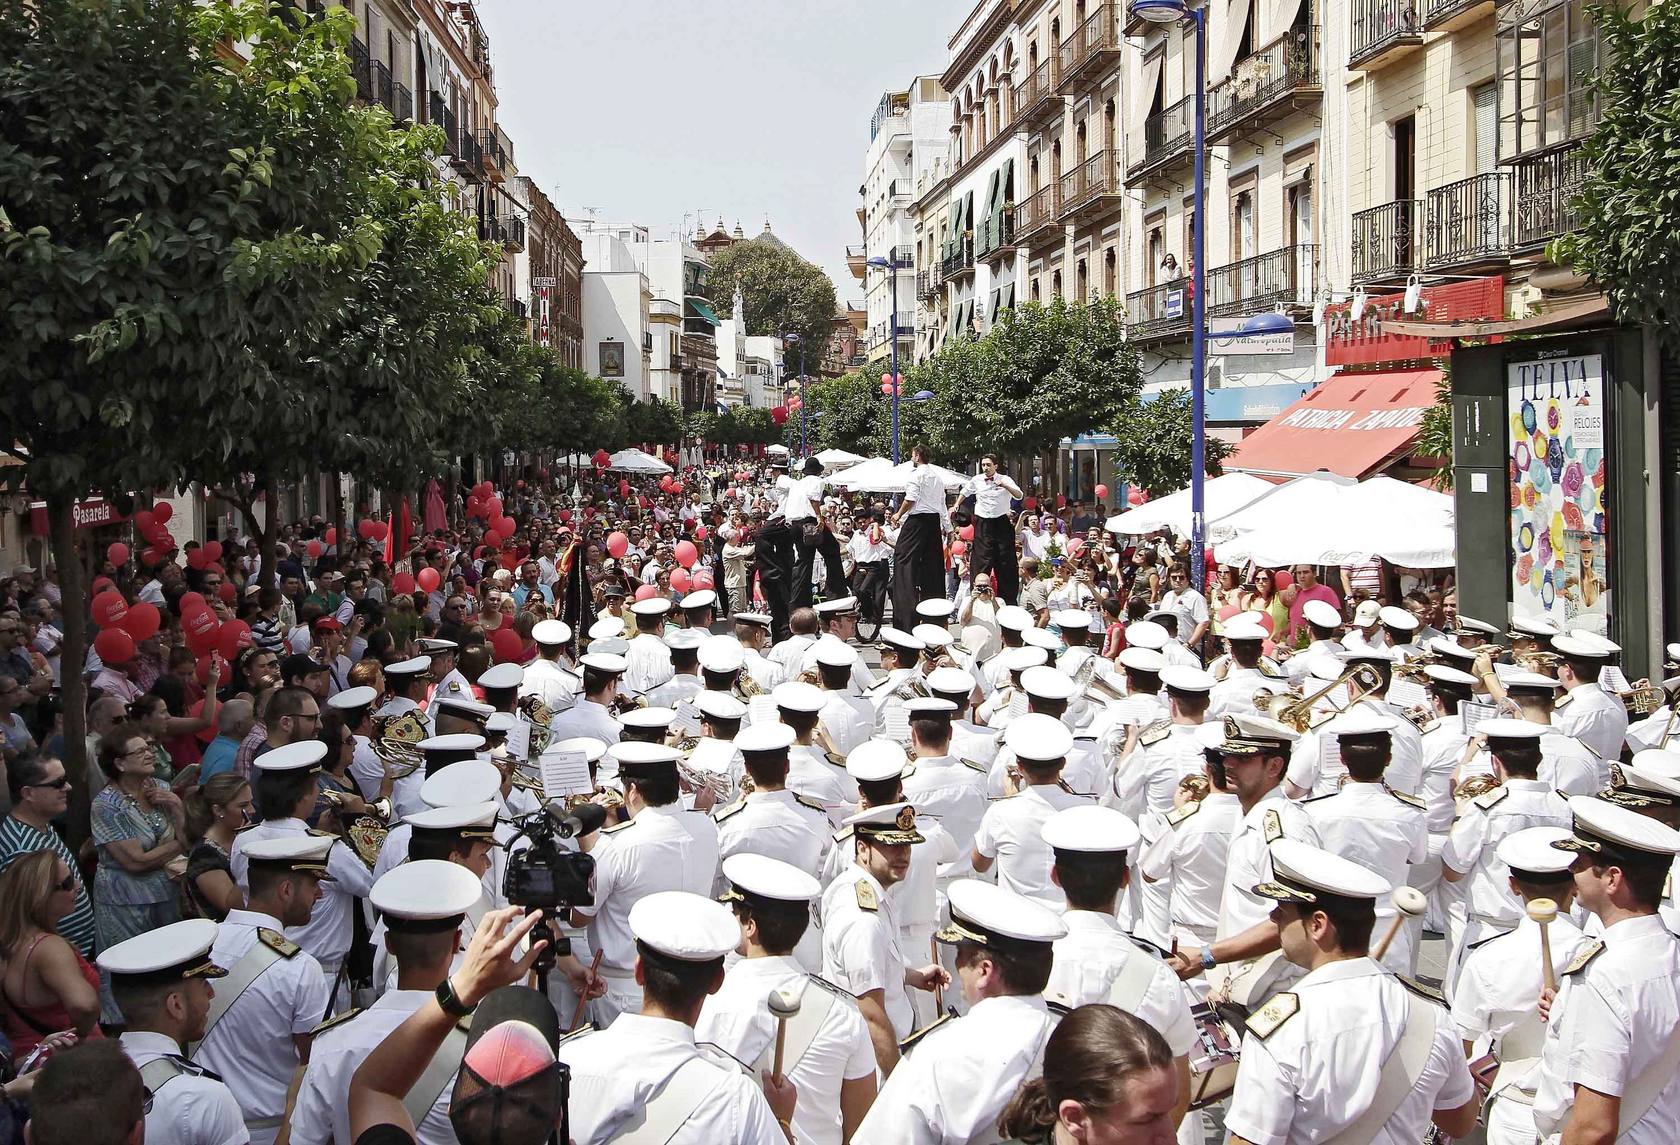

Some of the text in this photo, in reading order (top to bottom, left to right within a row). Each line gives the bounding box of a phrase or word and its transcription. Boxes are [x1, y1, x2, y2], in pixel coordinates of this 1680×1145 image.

[1518, 359, 1590, 402] TELVA
[1278, 408, 1355, 429] PATRICIA
[1574, 417, 1601, 429] RELOJES
[73, 504, 110, 528] Pasarela
